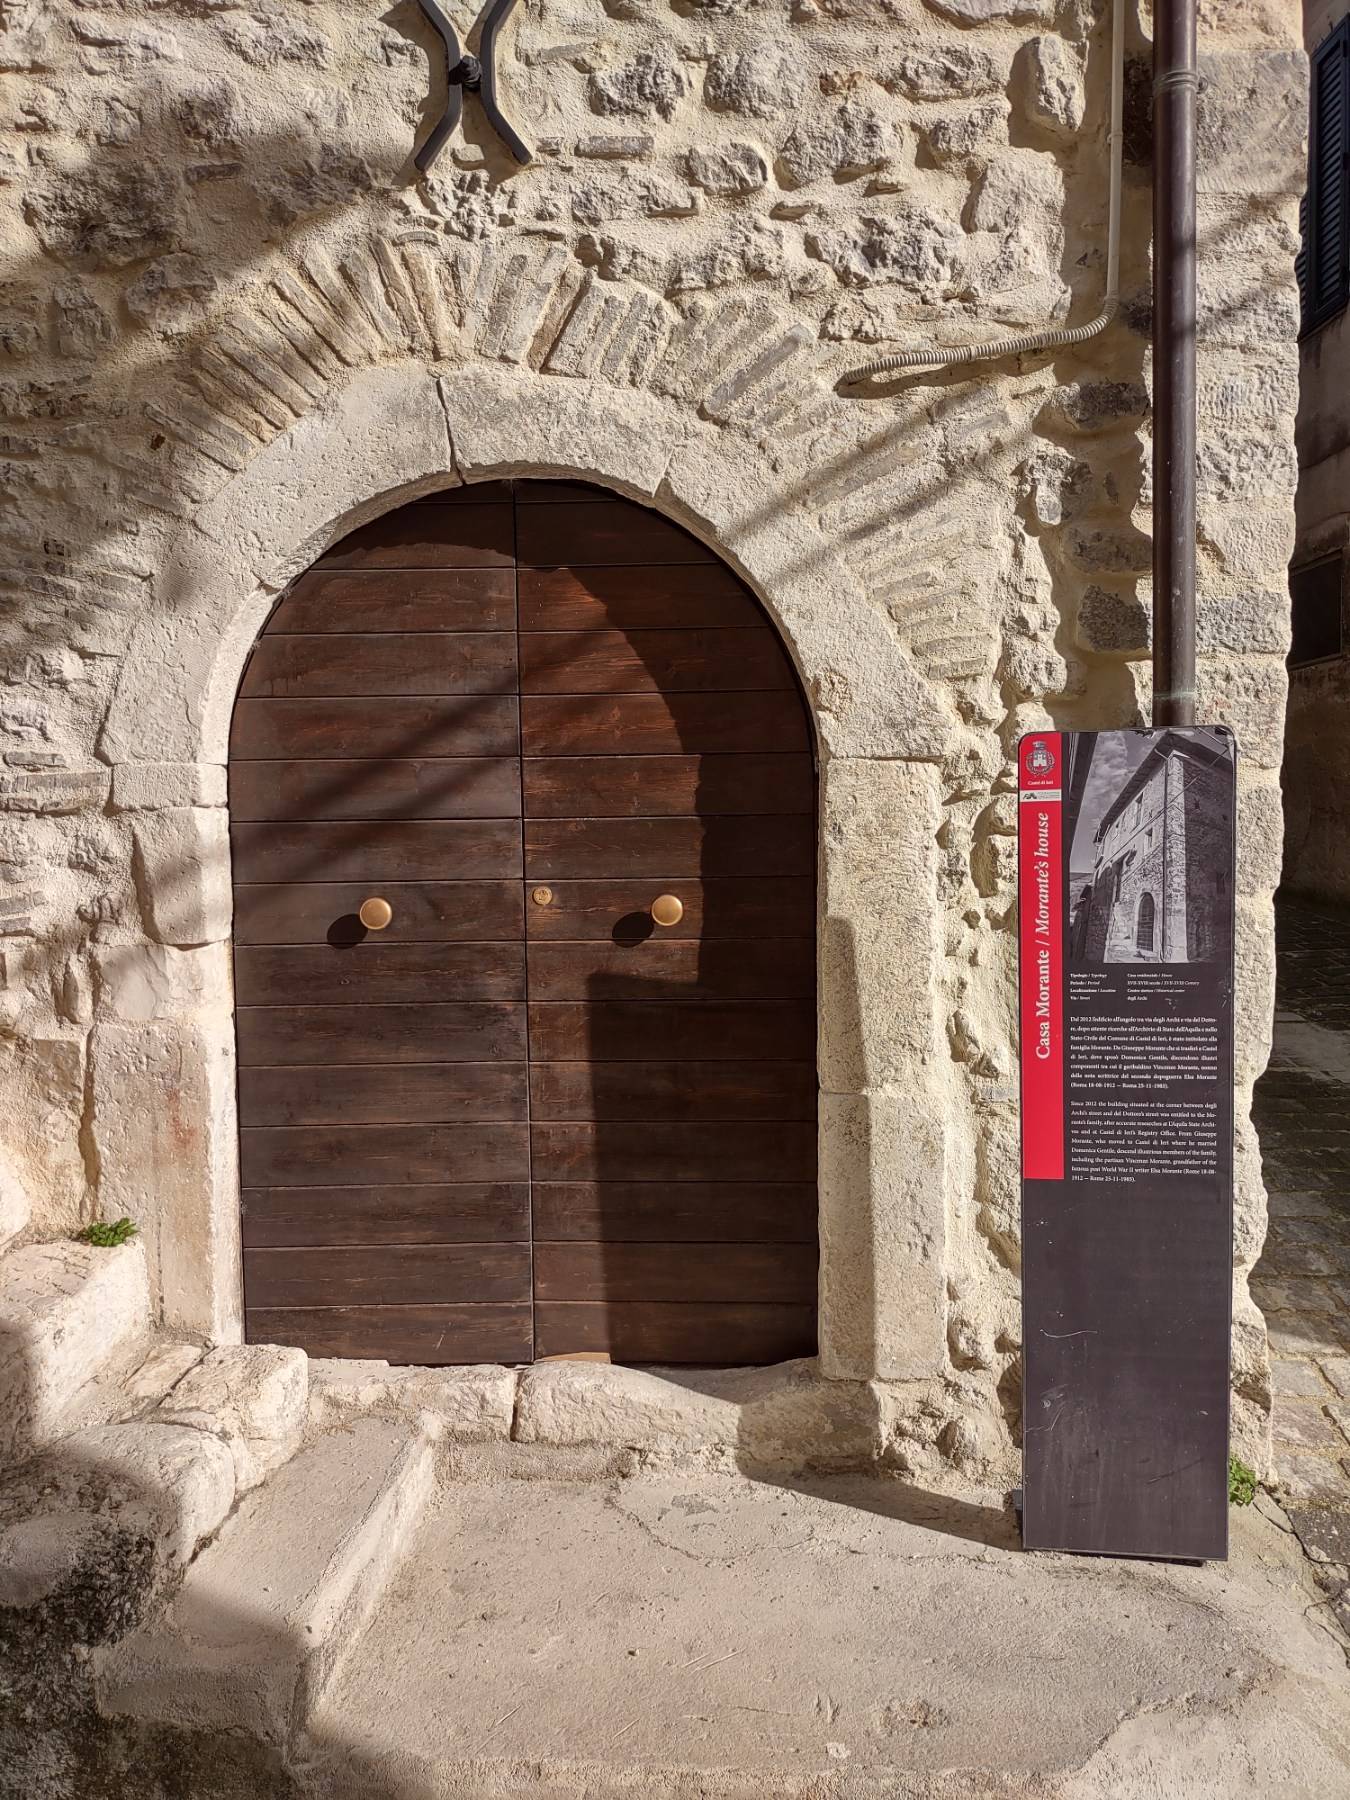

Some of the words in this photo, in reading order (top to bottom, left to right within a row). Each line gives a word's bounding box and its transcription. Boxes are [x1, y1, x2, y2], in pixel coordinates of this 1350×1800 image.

[1034, 812, 1049, 856] house
[1034, 864, 1050, 936] Morante's
[1036, 950, 1050, 1016] Morante
[1036, 1022, 1050, 1059] Casa
